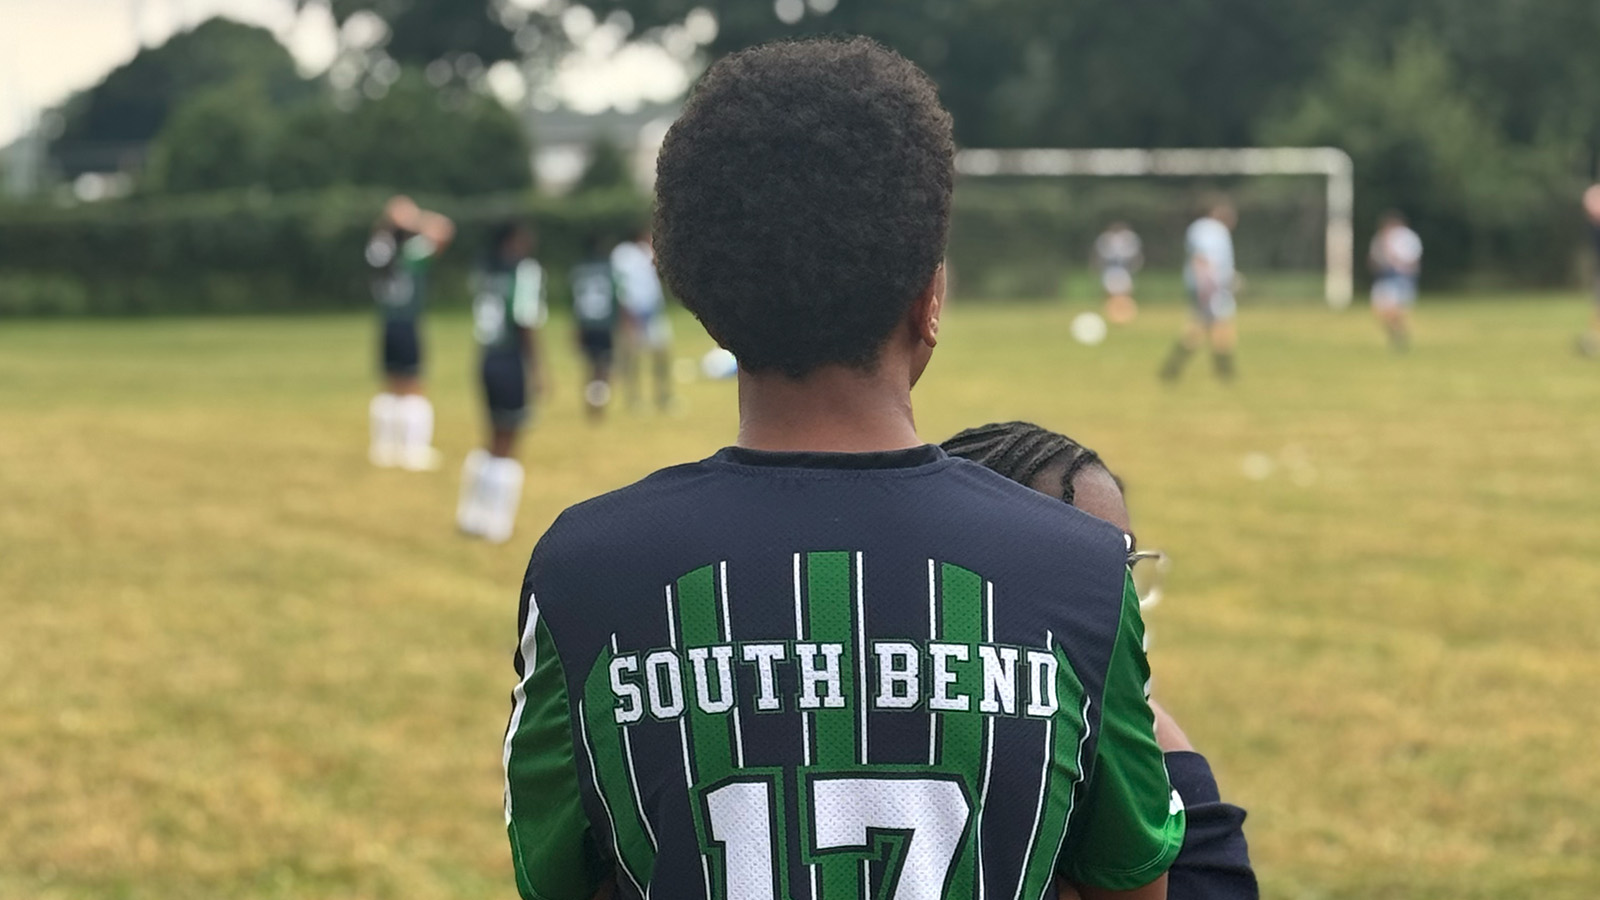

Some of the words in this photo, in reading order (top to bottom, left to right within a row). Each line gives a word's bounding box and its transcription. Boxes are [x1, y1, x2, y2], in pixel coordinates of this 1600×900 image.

[608, 642, 846, 724] SOUTH
[874, 642, 1059, 717] BEND
[706, 778, 970, 900] 17
